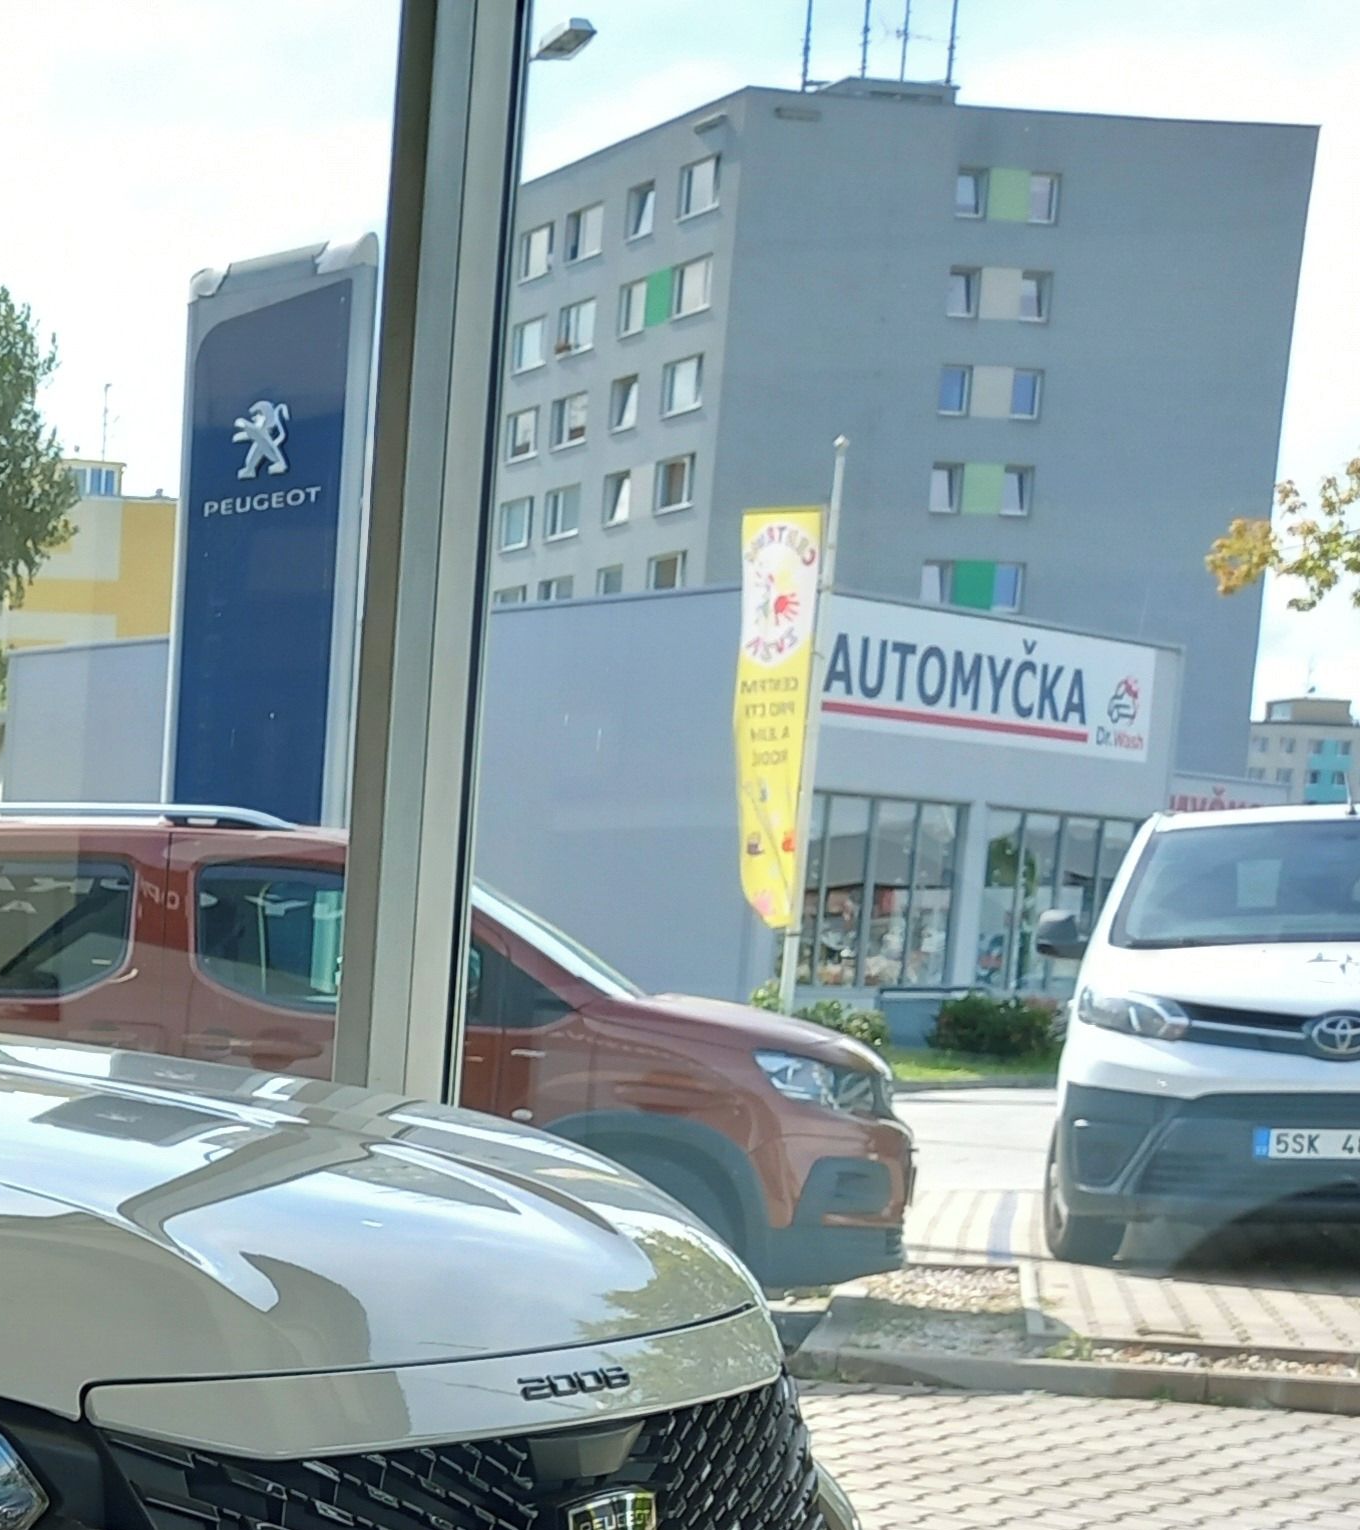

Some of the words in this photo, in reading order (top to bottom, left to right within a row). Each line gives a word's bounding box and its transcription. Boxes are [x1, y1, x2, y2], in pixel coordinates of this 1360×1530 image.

[203, 486, 322, 518] PEUGEOT
[821, 632, 1088, 726] AUTOMYČKA
[1275, 1132, 1321, 1155] 5SK
[1341, 1133, 1360, 1155] 4
